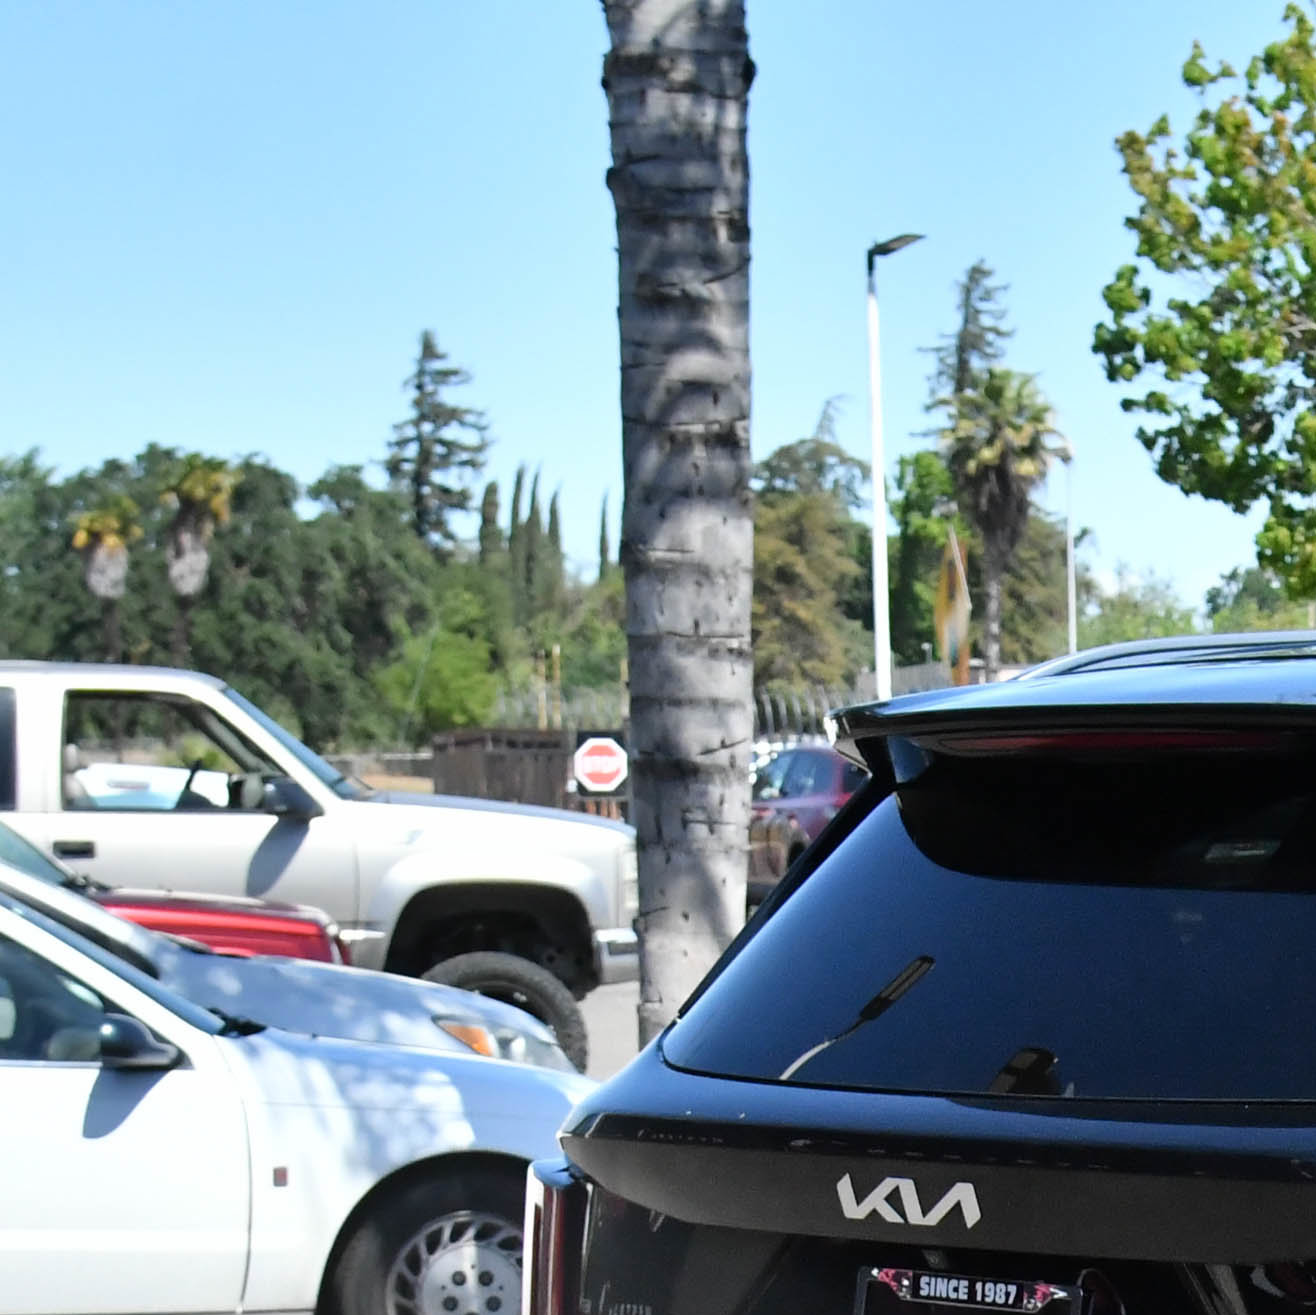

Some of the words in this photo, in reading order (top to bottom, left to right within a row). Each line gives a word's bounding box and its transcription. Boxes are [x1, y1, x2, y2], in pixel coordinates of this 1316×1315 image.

[836, 1172, 982, 1229] KIA
[919, 1275, 969, 1301] SINCE
[975, 1281, 1017, 1304] 1987
